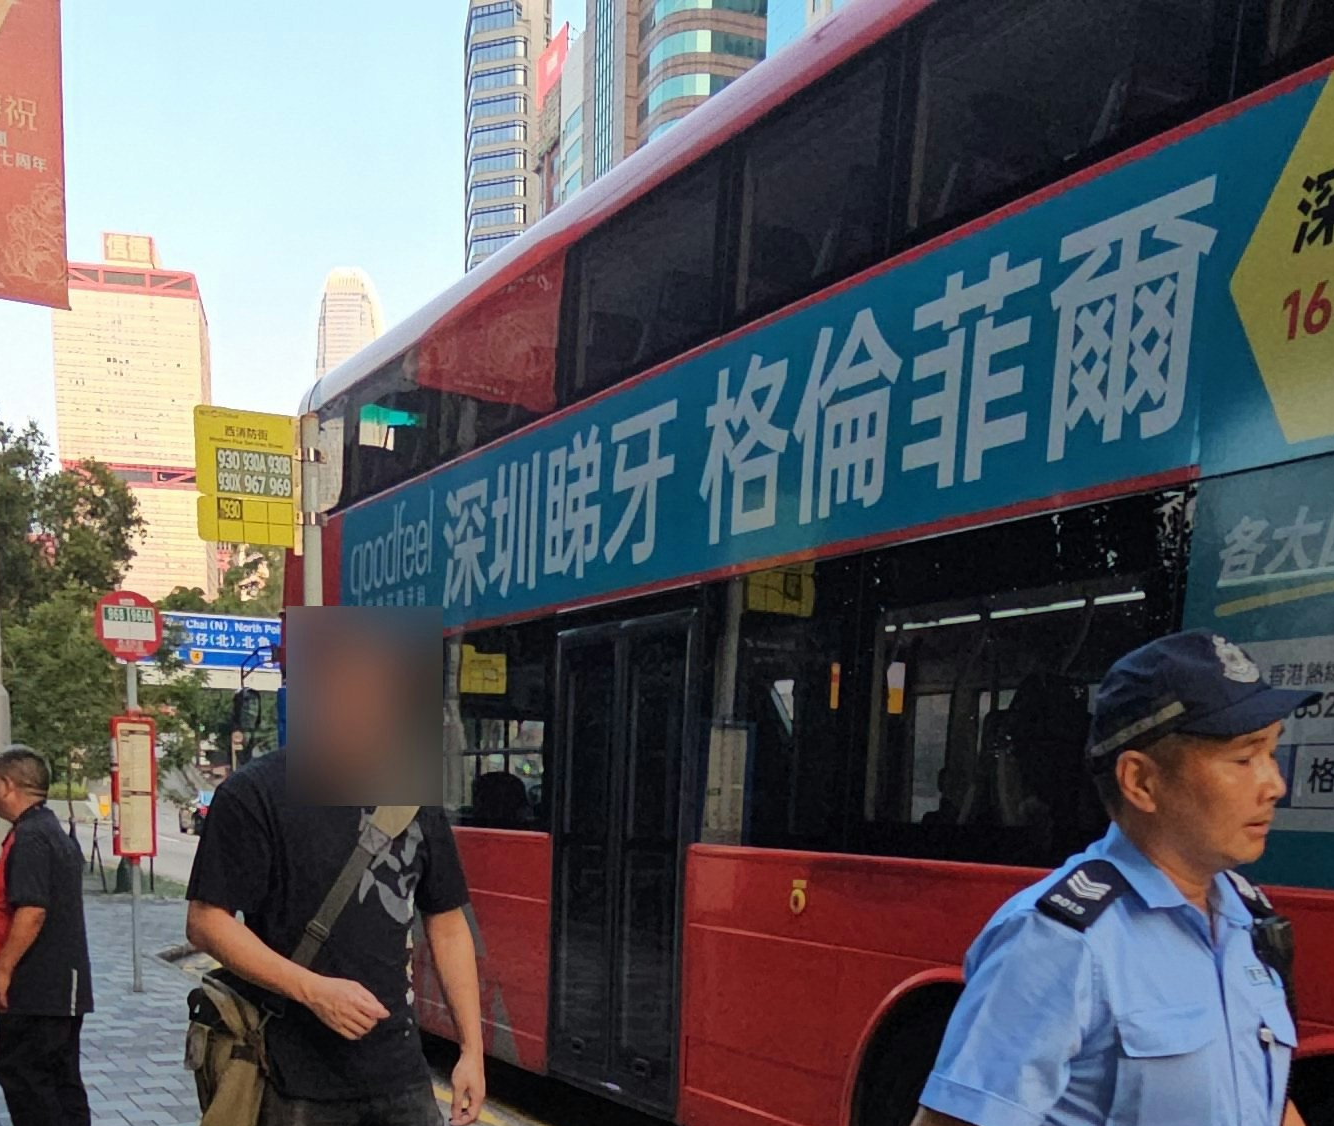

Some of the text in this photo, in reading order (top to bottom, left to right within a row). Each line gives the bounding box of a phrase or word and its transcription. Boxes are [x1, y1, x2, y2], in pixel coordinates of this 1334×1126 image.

[443, 174, 1218, 607] 深圳睇牙 格倫菲爾
[217, 450, 291, 475] 930 930A 930B
[218, 472, 291, 496] 930X 967 969
[350, 487, 435, 606] goodfeel
[186, 619, 208, 630] Chai
[235, 623, 262, 633] North
